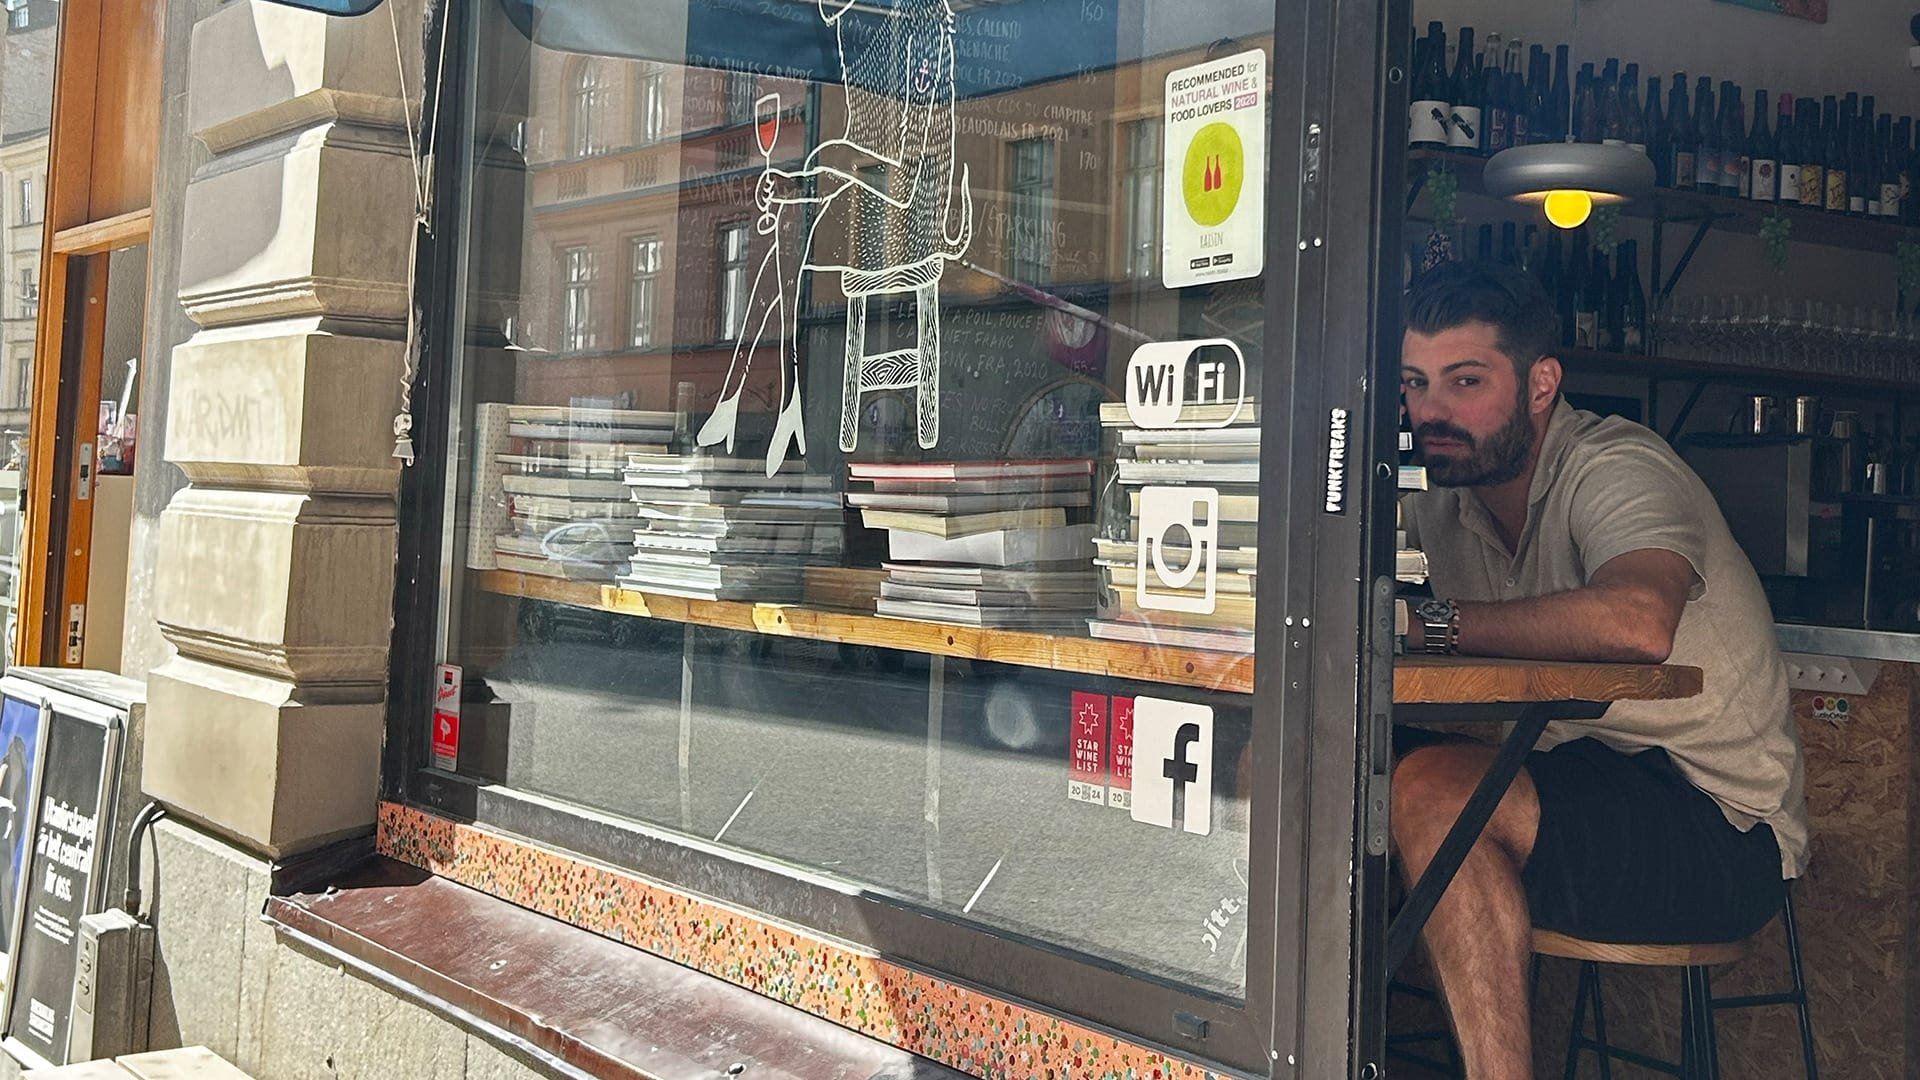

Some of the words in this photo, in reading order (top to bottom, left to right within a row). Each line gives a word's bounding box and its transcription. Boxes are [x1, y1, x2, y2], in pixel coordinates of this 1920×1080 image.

[1171, 64, 1245, 93] RECOMMENDED
[1247, 62, 1258, 74] for
[1171, 86, 1219, 109] NATURAL
[1221, 78, 1249, 96] WINE
[1250, 77, 1257, 89] &
[1171, 107, 1196, 124] FOOD
[1197, 99, 1232, 117] LOVERS
[1041, 125, 1069, 142] 2021
[1013, 358, 1048, 380] 2020
[1135, 364, 1175, 407] Wi
[1197, 362, 1225, 405] Fi
[1325, 407, 1348, 513] FUNKFREAKS
[1077, 738, 1099, 751] STAR
[1117, 744, 1132, 756] STA
[1075, 749, 1099, 762] WINE
[1115, 754, 1132, 767] WIN
[1076, 759, 1098, 773] LIST
[1116, 766, 1132, 778] LIS
[1071, 785, 1081, 795] 20
[1112, 792, 1123, 802] 20
